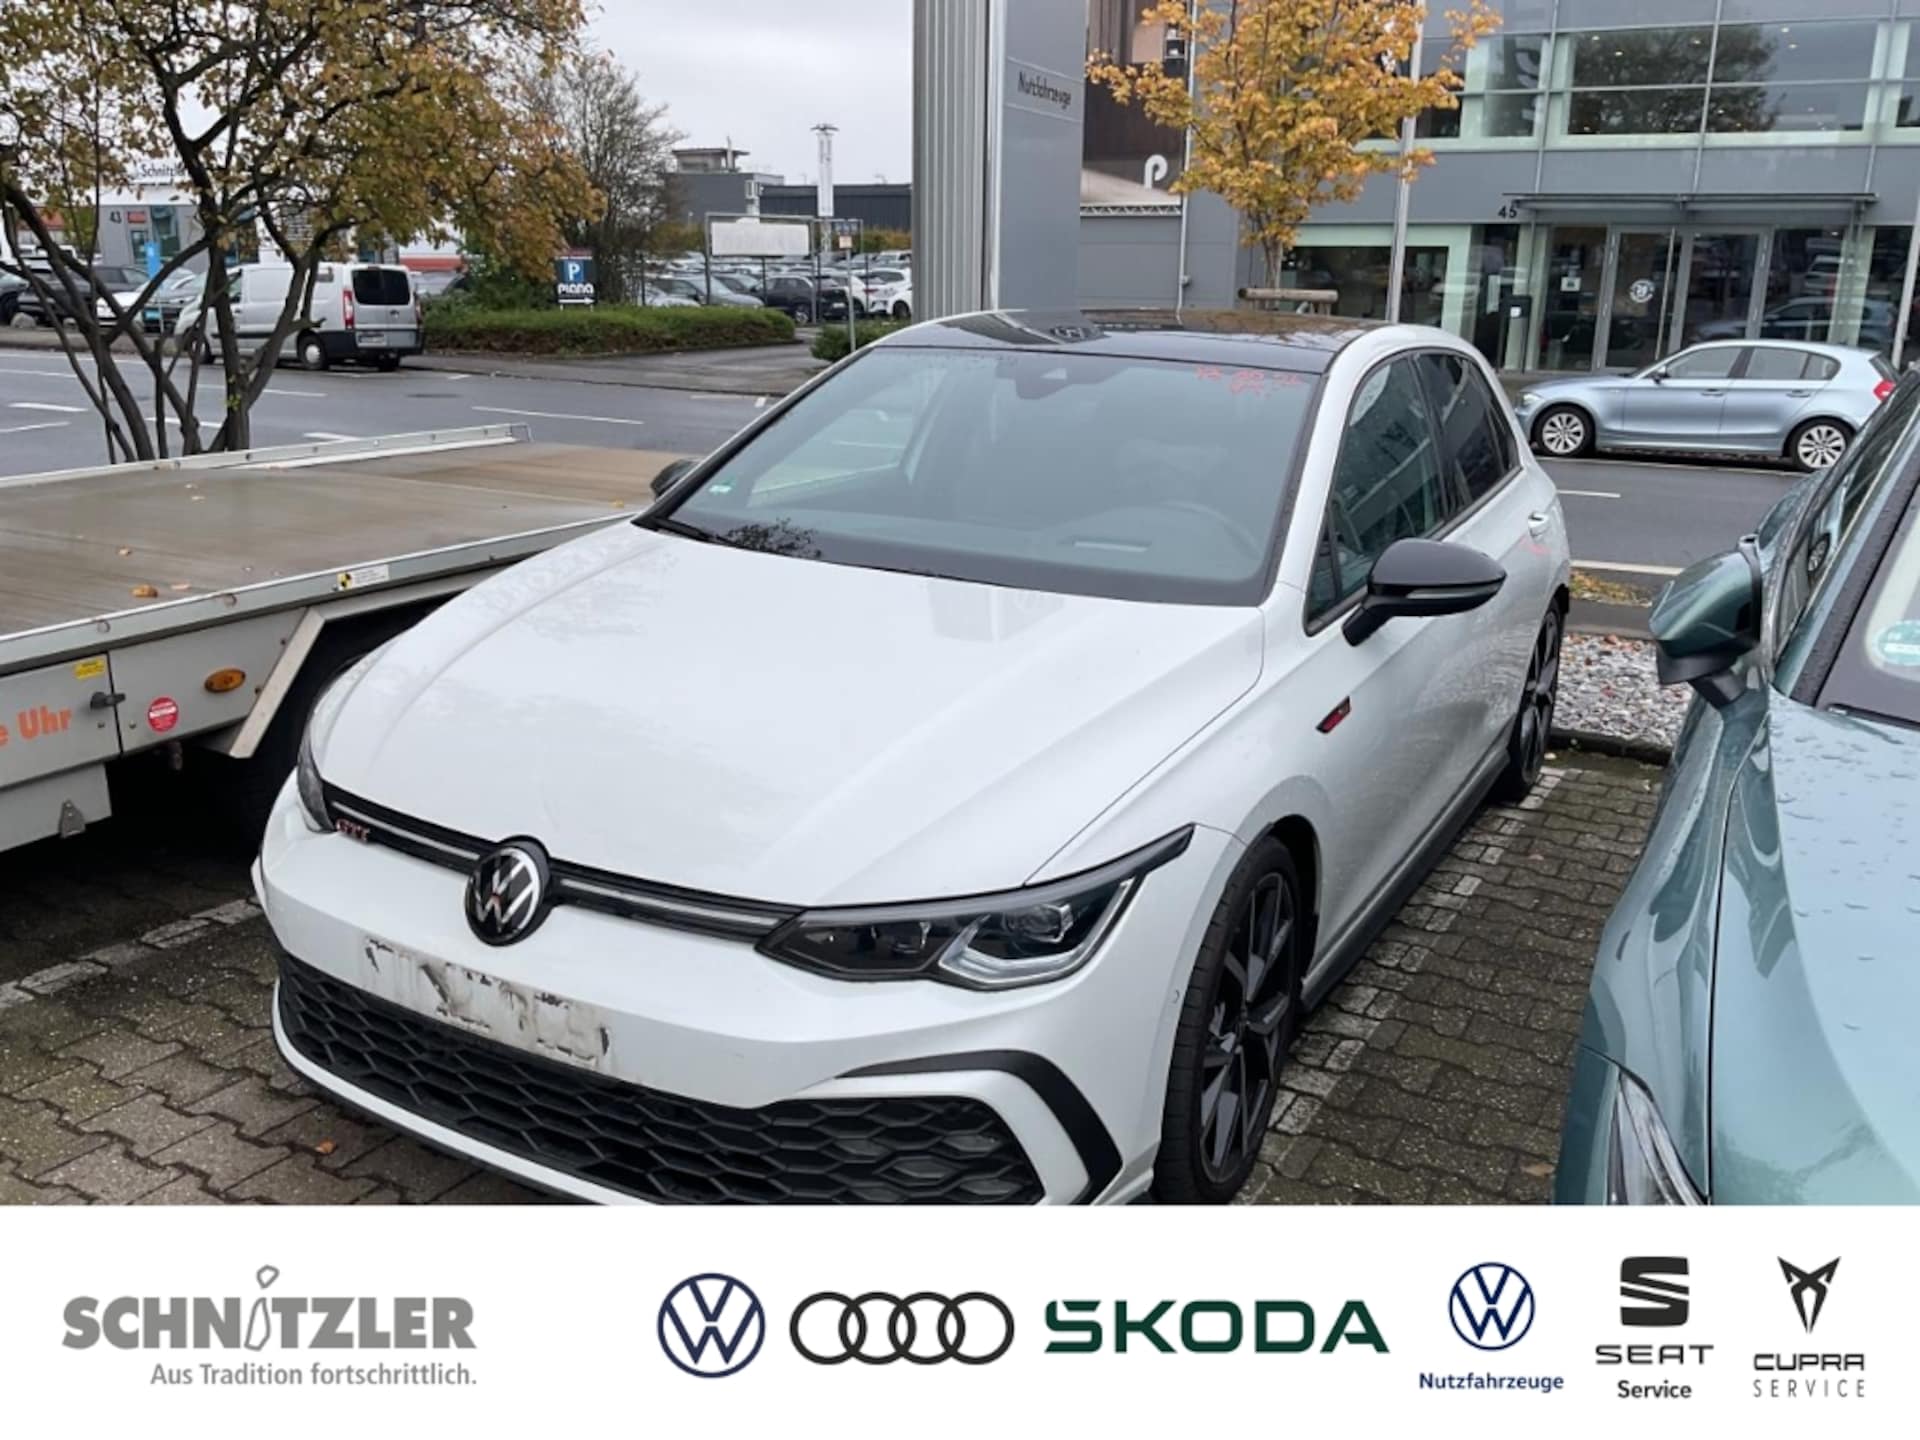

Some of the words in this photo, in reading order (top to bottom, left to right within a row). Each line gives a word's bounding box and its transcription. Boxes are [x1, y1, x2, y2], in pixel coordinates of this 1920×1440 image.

[1018, 71, 1072, 109] Nutzfahrzeuge
[109, 210, 122, 224] 43
[1498, 206, 1517, 218] 45
[18, 705, 72, 739] Uhr
